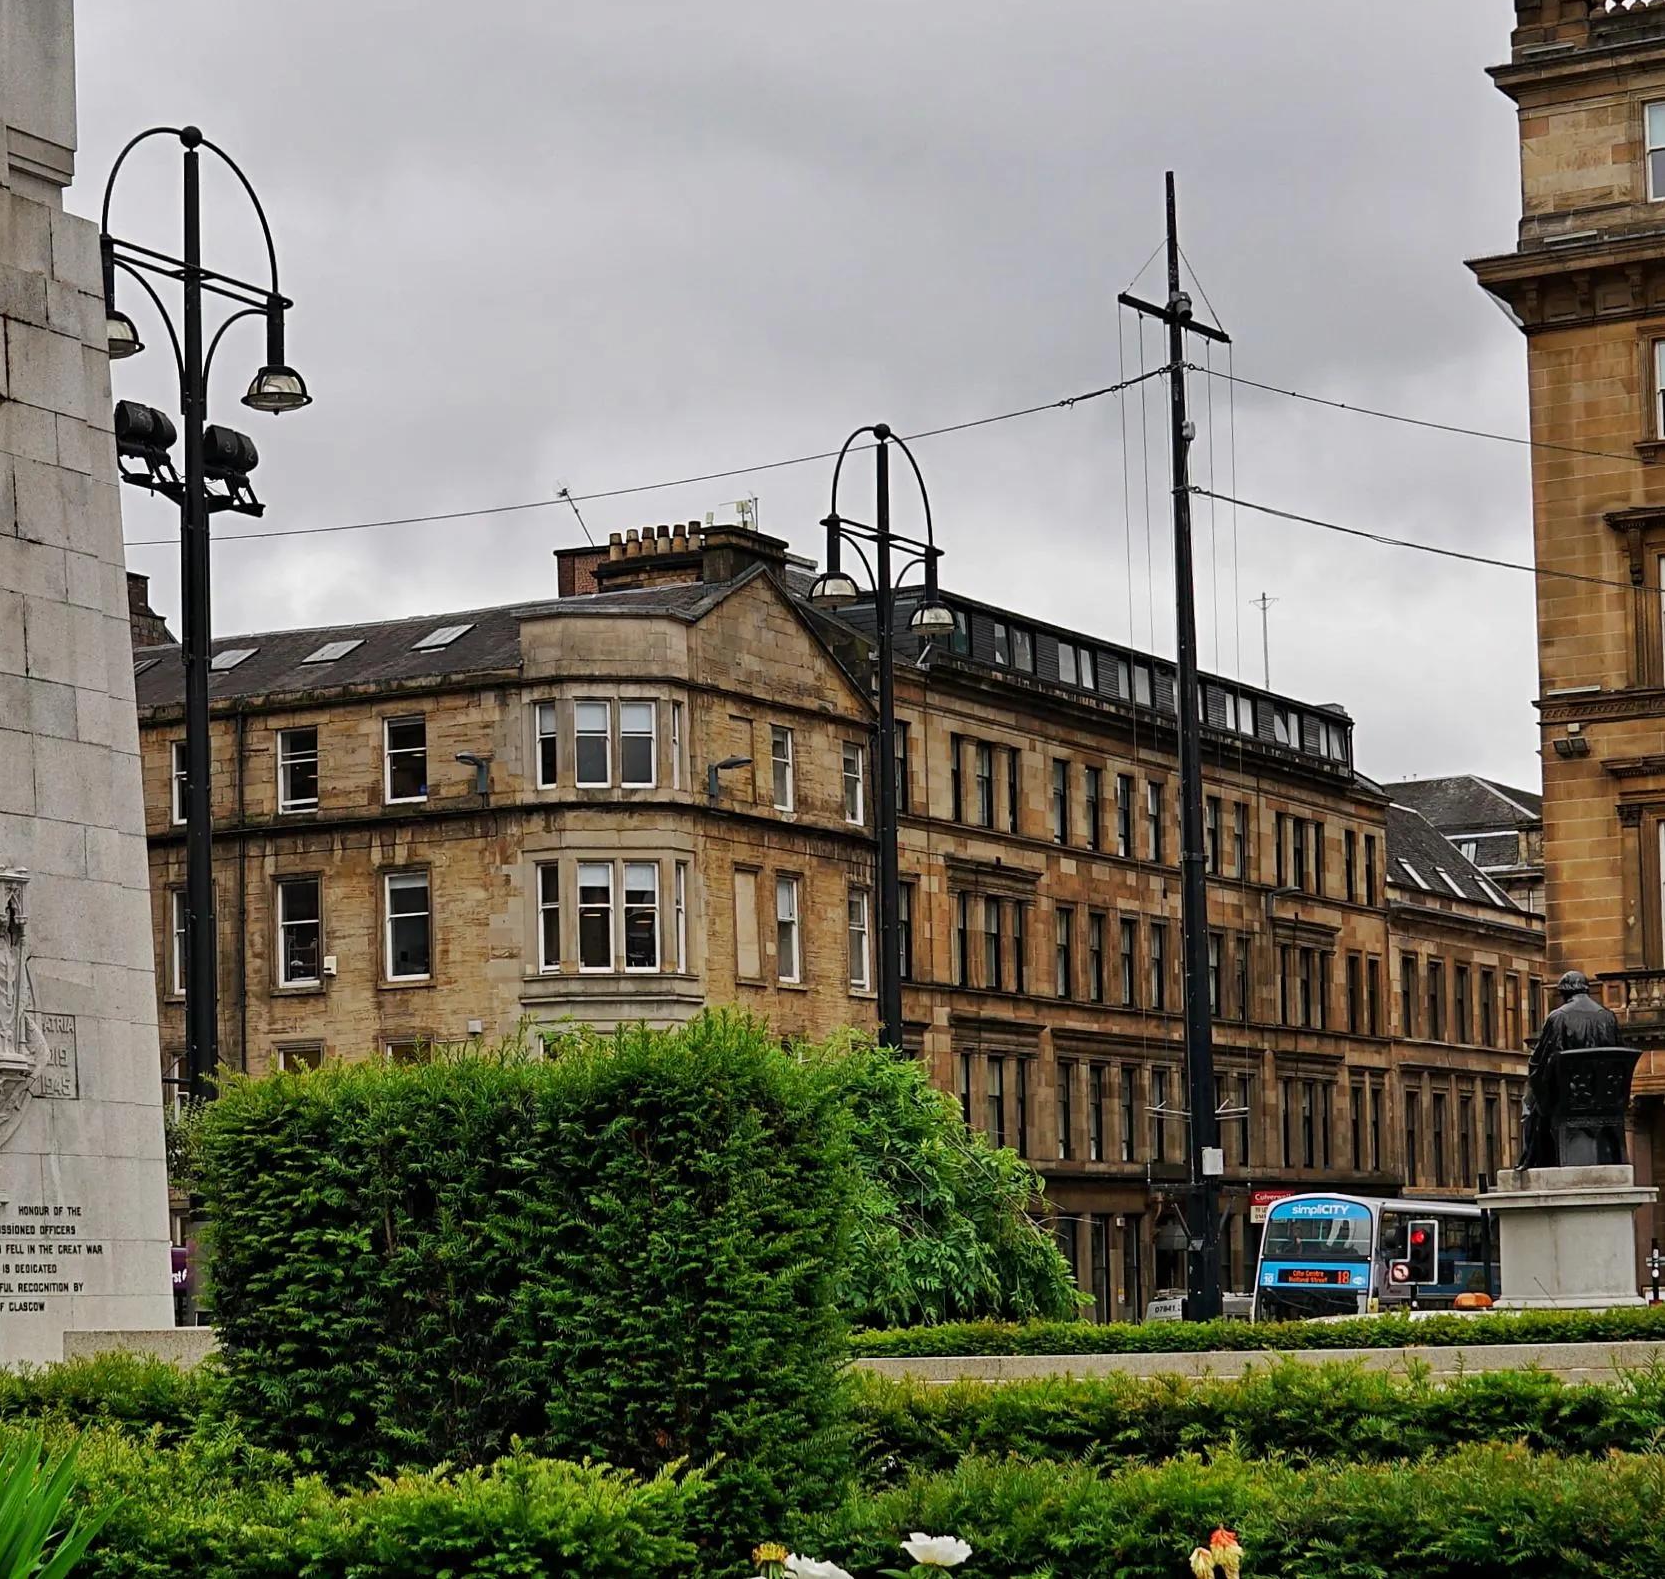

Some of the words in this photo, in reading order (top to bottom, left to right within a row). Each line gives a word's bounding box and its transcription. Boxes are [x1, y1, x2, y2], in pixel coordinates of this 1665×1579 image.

[43, 1016, 74, 1034] ATRIA
[17, 1205, 50, 1217] HONOUR
[53, 1205, 64, 1217] OF
[67, 1206, 82, 1217] THE
[1291, 1204, 1350, 1216] simpliCITY
[39, 1224, 77, 1236] OFFICERS
[5, 1244, 24, 1255] FELL
[26, 1244, 36, 1255] IN
[38, 1244, 54, 1255] THE
[57, 1244, 82, 1255] GREAT
[86, 1244, 104, 1255] WAR
[1, 1264, 11, 1275] IS
[14, 1264, 58, 1274] DEDICATED
[1337, 1271, 1350, 1284] 18
[17, 1282, 69, 1293] RECOGNITION
[73, 1281, 85, 1293] BY
[8, 1301, 46, 1313] GLASGOW
